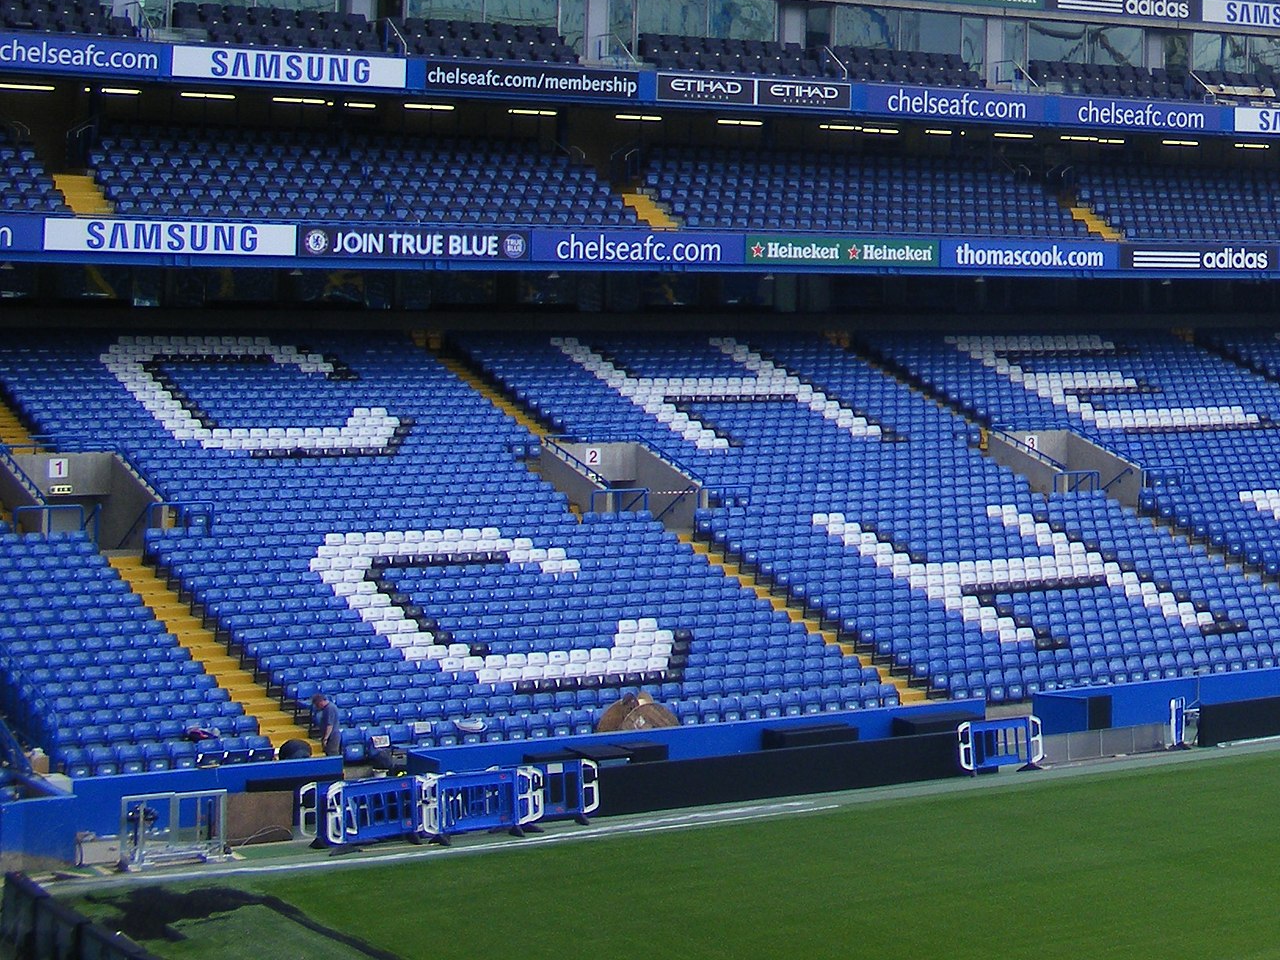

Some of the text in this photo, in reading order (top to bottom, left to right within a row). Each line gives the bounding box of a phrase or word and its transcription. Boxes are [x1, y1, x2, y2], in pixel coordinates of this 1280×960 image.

[0, 40, 158, 69] chelseafc.com
[211, 50, 370, 83] SAMSUNG
[427, 67, 637, 97] chelseafc.com/membership
[671, 80, 742, 94] ETIHAD
[770, 84, 839, 98] ETIHAD
[888, 90, 1026, 119] chelseafc.com
[1078, 101, 1204, 128] chelseafc.com
[87, 221, 257, 251] SAMSUNG
[333, 232, 384, 254] JOIN
[389, 233, 443, 255] TRUE
[448, 235, 498, 256] BLUE
[556, 234, 721, 262] chelseafc.com
[767, 242, 933, 261] Heineken Heineken
[956, 244, 1103, 267] thomascook.com
[1203, 251, 1268, 269] adidas
[1028, 438, 1035, 449] 3
[589, 450, 597, 462] 2
